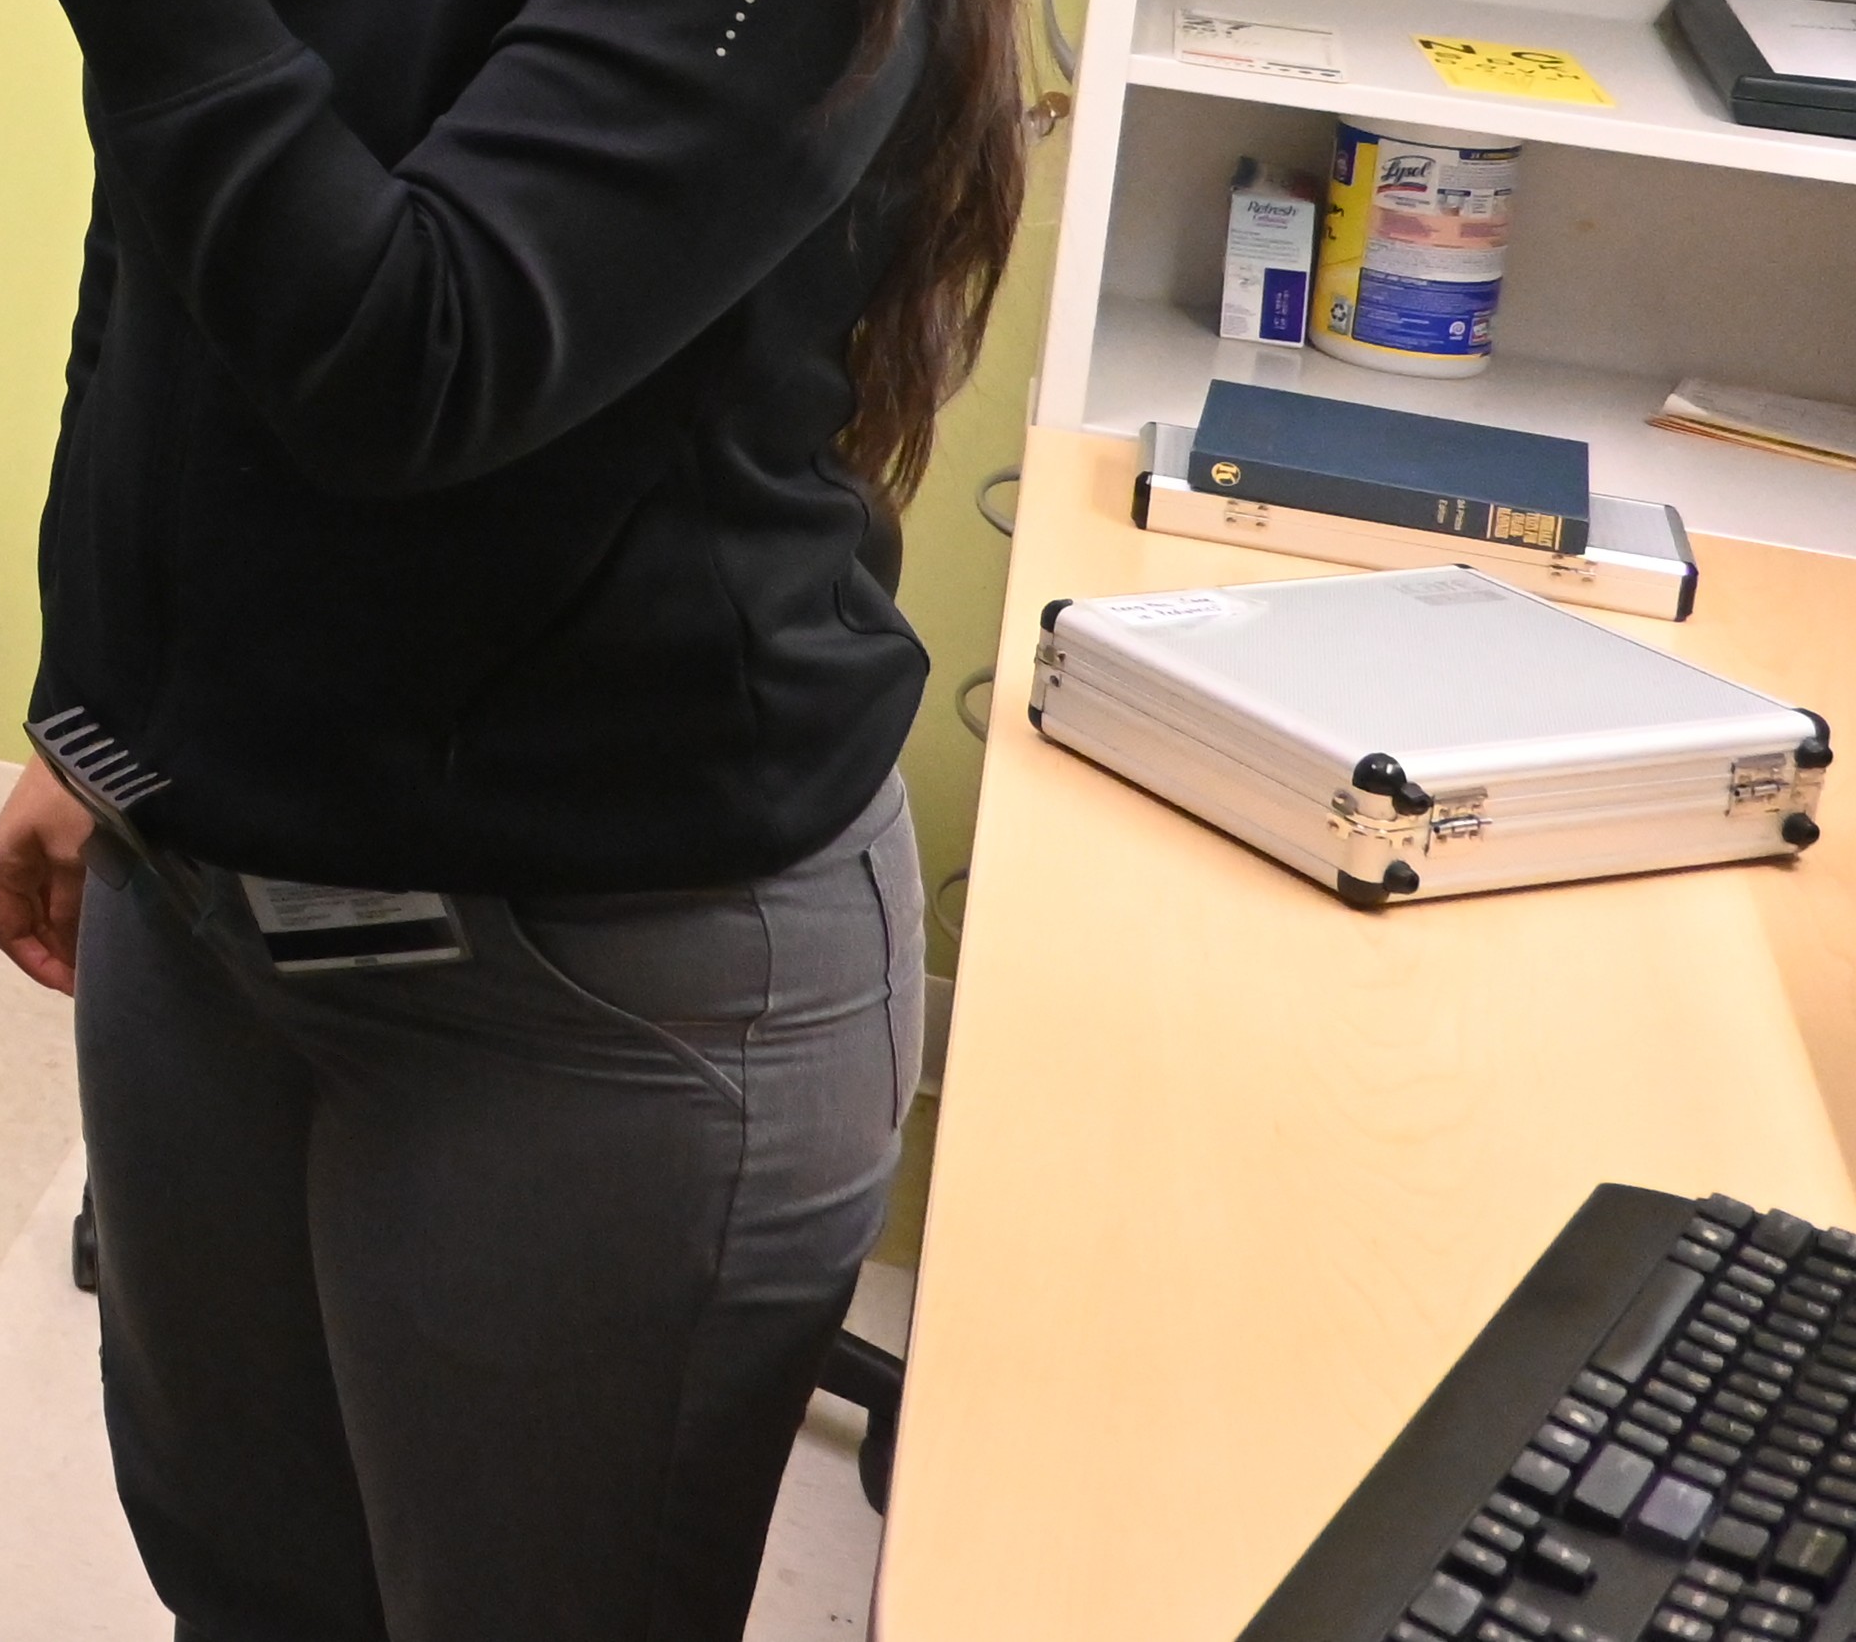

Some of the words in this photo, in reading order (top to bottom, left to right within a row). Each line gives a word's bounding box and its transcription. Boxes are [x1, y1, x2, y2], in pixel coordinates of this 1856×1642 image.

[1418, 38, 1477, 55] N
[1380, 159, 1429, 183] Lysol
[1247, 200, 1297, 217] Refresh
